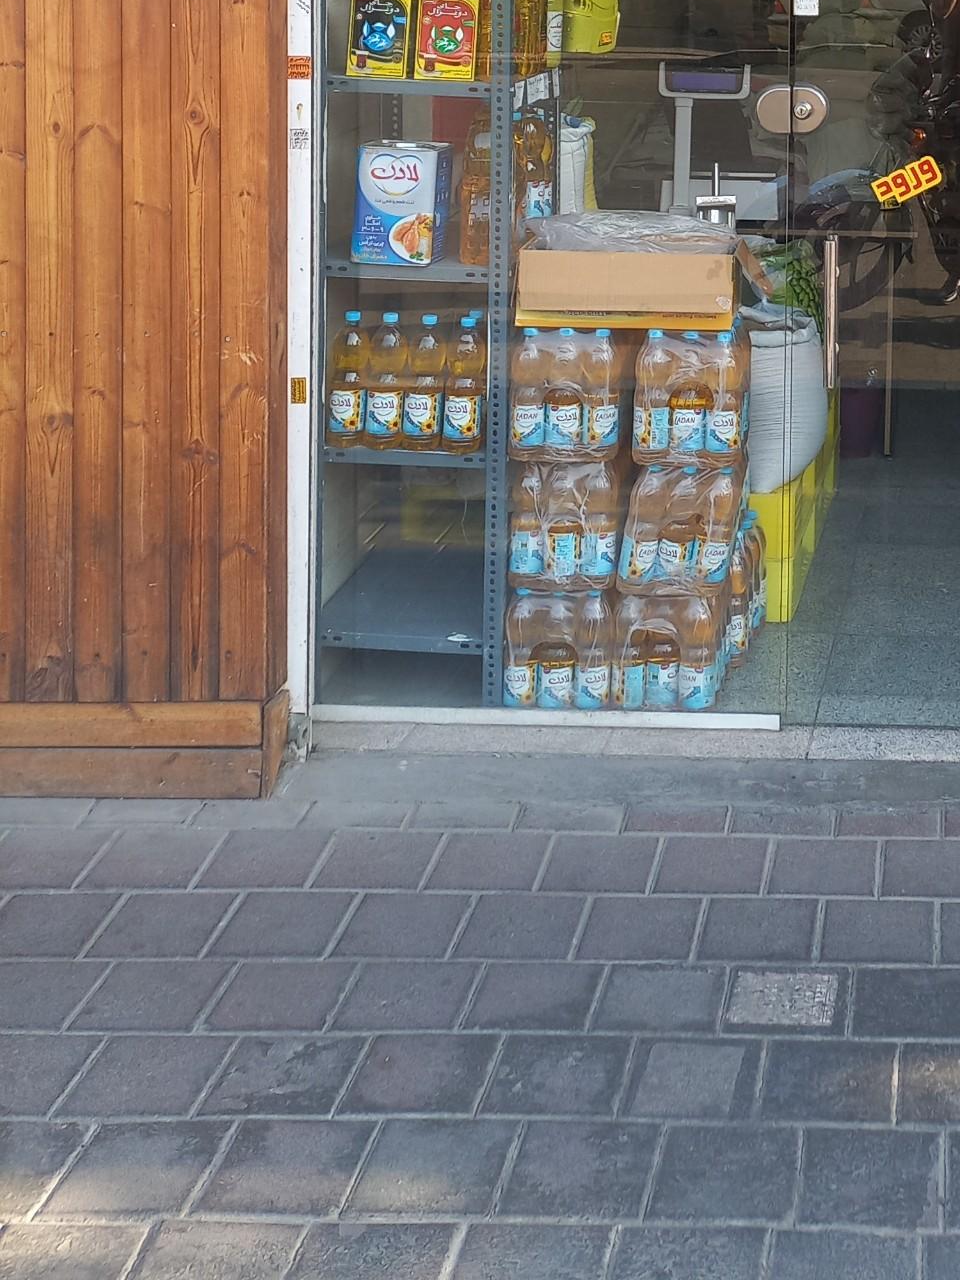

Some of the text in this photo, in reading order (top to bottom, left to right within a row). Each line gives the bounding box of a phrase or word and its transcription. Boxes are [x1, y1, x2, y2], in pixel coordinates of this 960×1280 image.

[371, 162, 419, 182] لادن
[873, 158, 940, 200] ورود
[331, 398, 351, 407] لادن
[373, 400, 394, 409] لادن
[408, 400, 428, 410] لادن
[448, 403, 467, 413] لادن
[556, 412, 577, 421] لادن
[713, 418, 733, 426] لادن
[548, 675, 570, 685] لادن
